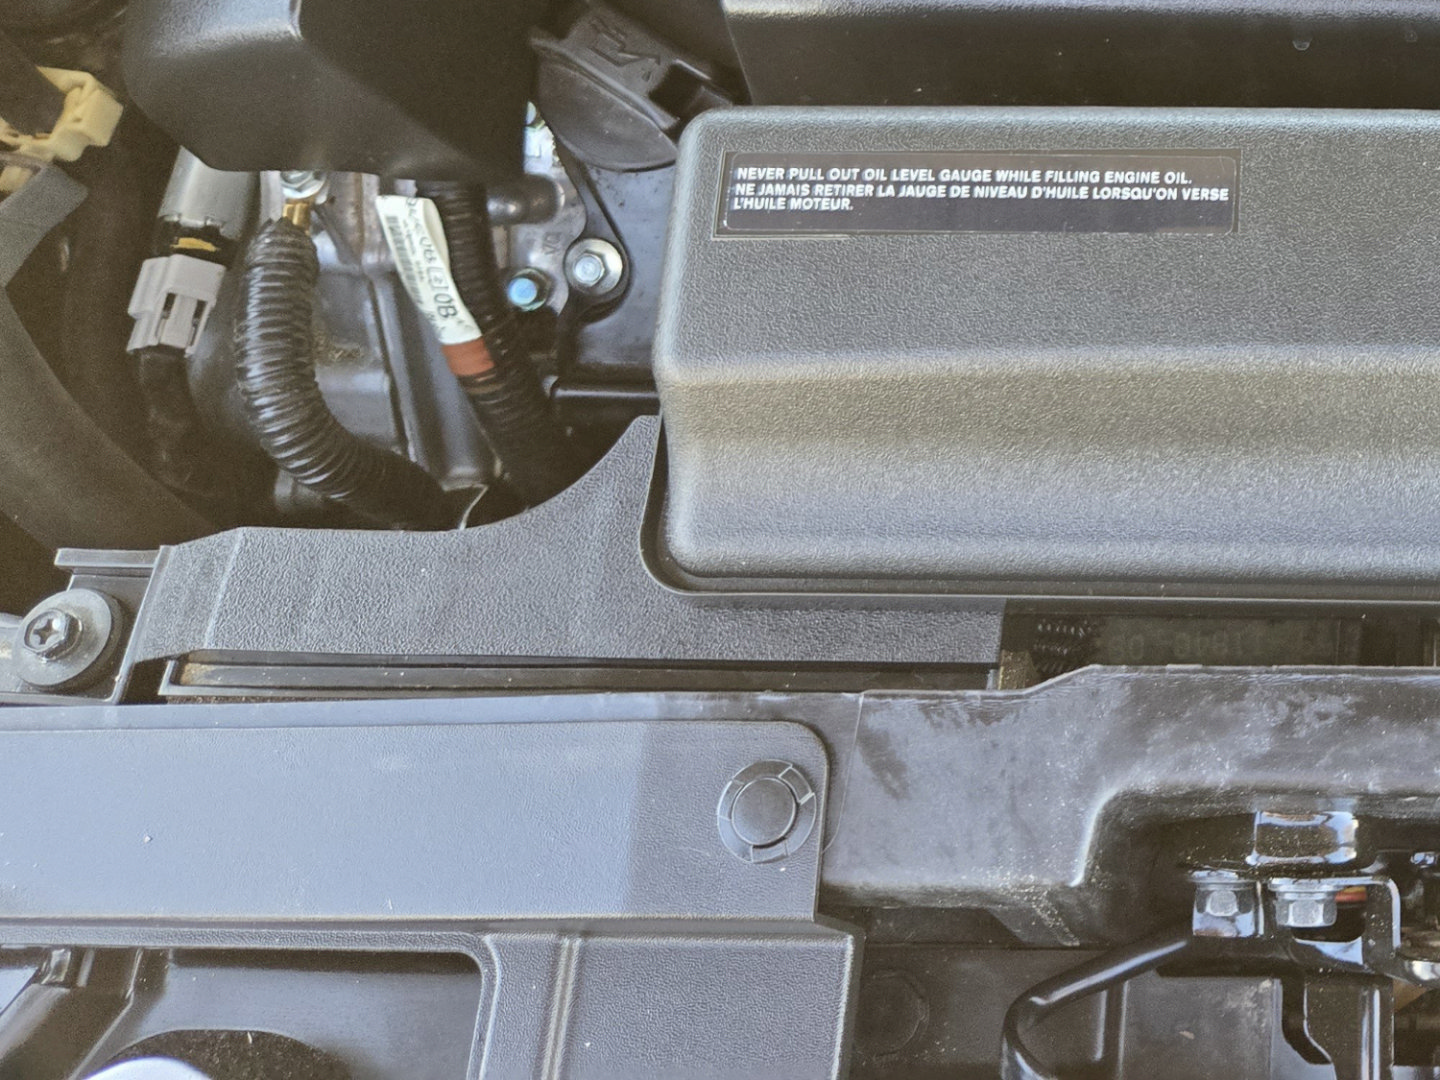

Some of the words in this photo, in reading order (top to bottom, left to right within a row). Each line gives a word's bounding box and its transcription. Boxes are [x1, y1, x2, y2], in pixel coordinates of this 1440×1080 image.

[736, 167, 785, 181] NEVER
[788, 167, 825, 181] PULL
[829, 168, 861, 181] OUT
[864, 168, 888, 181] OIL
[891, 168, 936, 182] LEVEL
[938, 169, 992, 182] GAUGE
[995, 169, 1041, 183] WHILE
[1044, 170, 1101, 184] FILLING
[1104, 170, 1161, 184] ENGINE
[1164, 171, 1193, 185] OIL.
[734, 183, 756, 196] NE
[757, 183, 810, 197] JAMAIS
[814, 184, 874, 197] RETIRER
[878, 184, 896, 197] LA
[898, 185, 946, 198] JAUGE
[950, 185, 971, 198] DE
[974, 185, 1028, 199] NIVEAU
[1030, 186, 1089, 199] D'HUILE
[1092, 186, 1178, 200] LORSQU'ON
[1181, 187, 1230, 201] VERSE
[732, 197, 786, 210] L'HUILE
[789, 197, 854, 211] MOTEUR.
